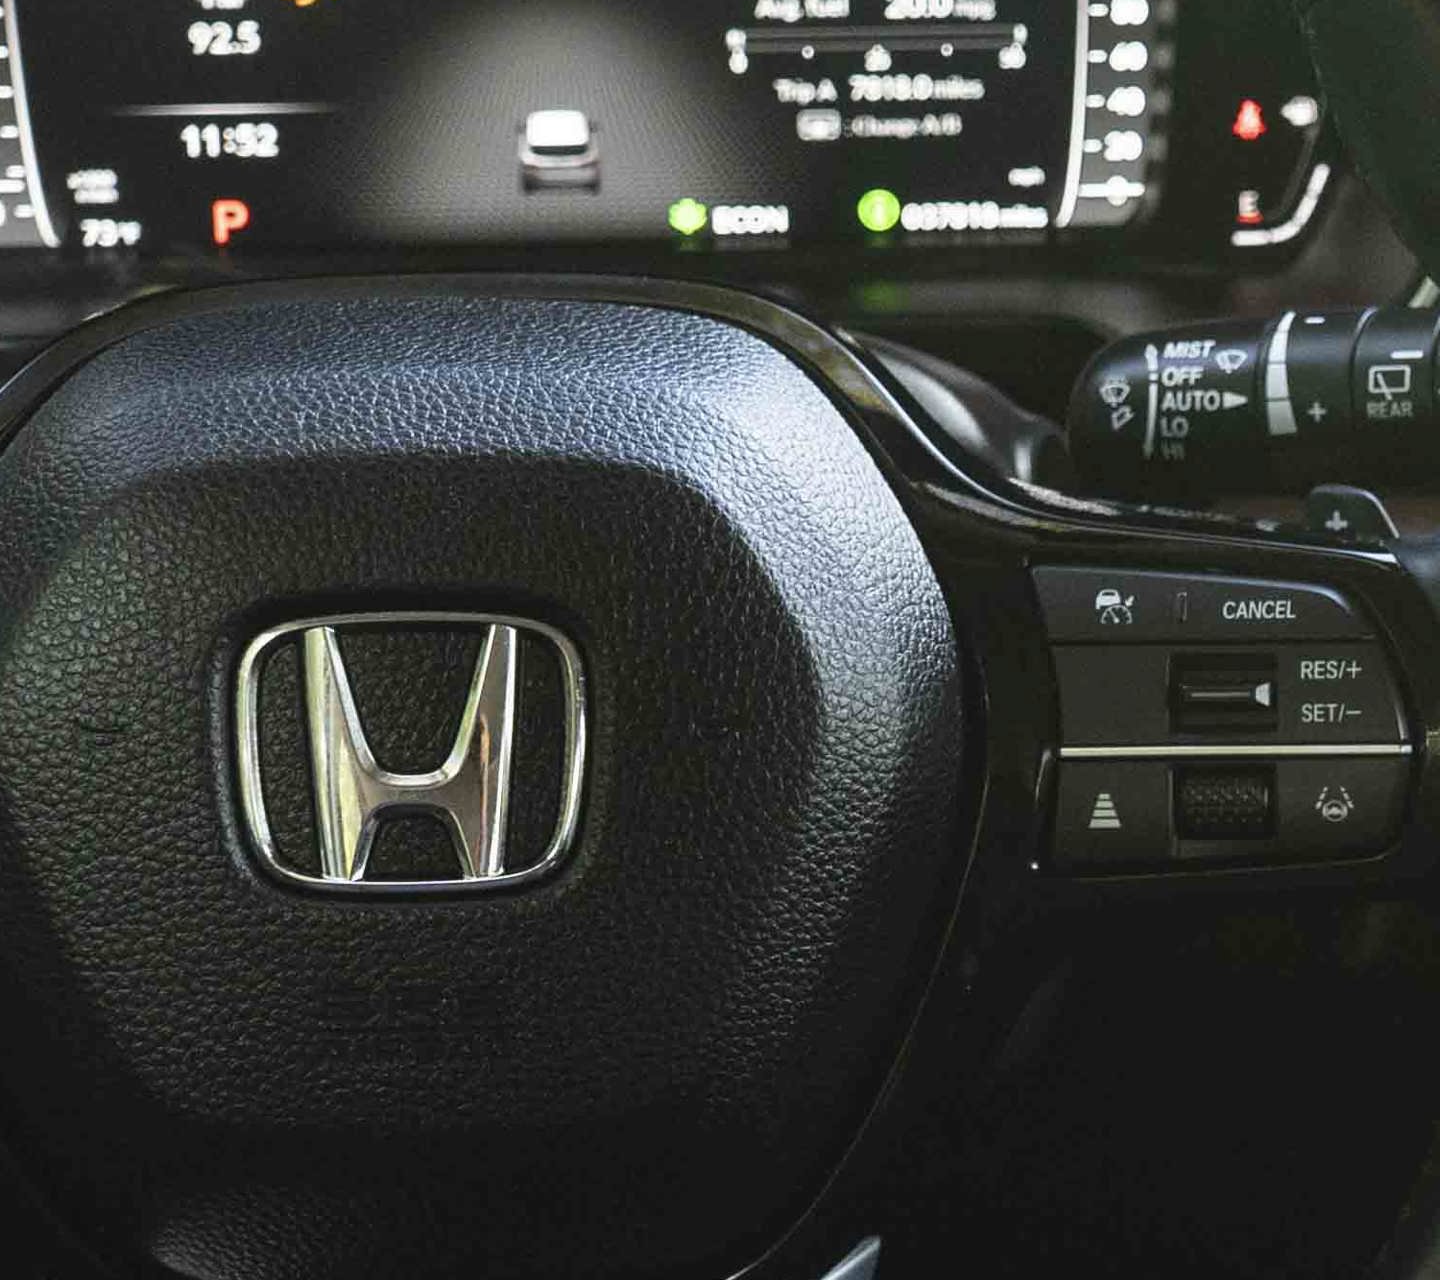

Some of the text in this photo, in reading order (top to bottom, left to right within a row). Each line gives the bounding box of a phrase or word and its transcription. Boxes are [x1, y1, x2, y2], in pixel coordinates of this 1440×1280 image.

[188, 20, 262, 55] 92.5
[181, 123, 279, 158] 11:52
[212, 199, 252, 245] P
[1162, 340, 1216, 360] MIST
[1161, 367, 1205, 387] OFF
[1161, 389, 1222, 412] AUTO
[1366, 401, 1413, 419] REAR
[1161, 416, 1189, 439] LO
[1222, 599, 1297, 620] CANCEL
[1300, 660, 1363, 681] RES/+
